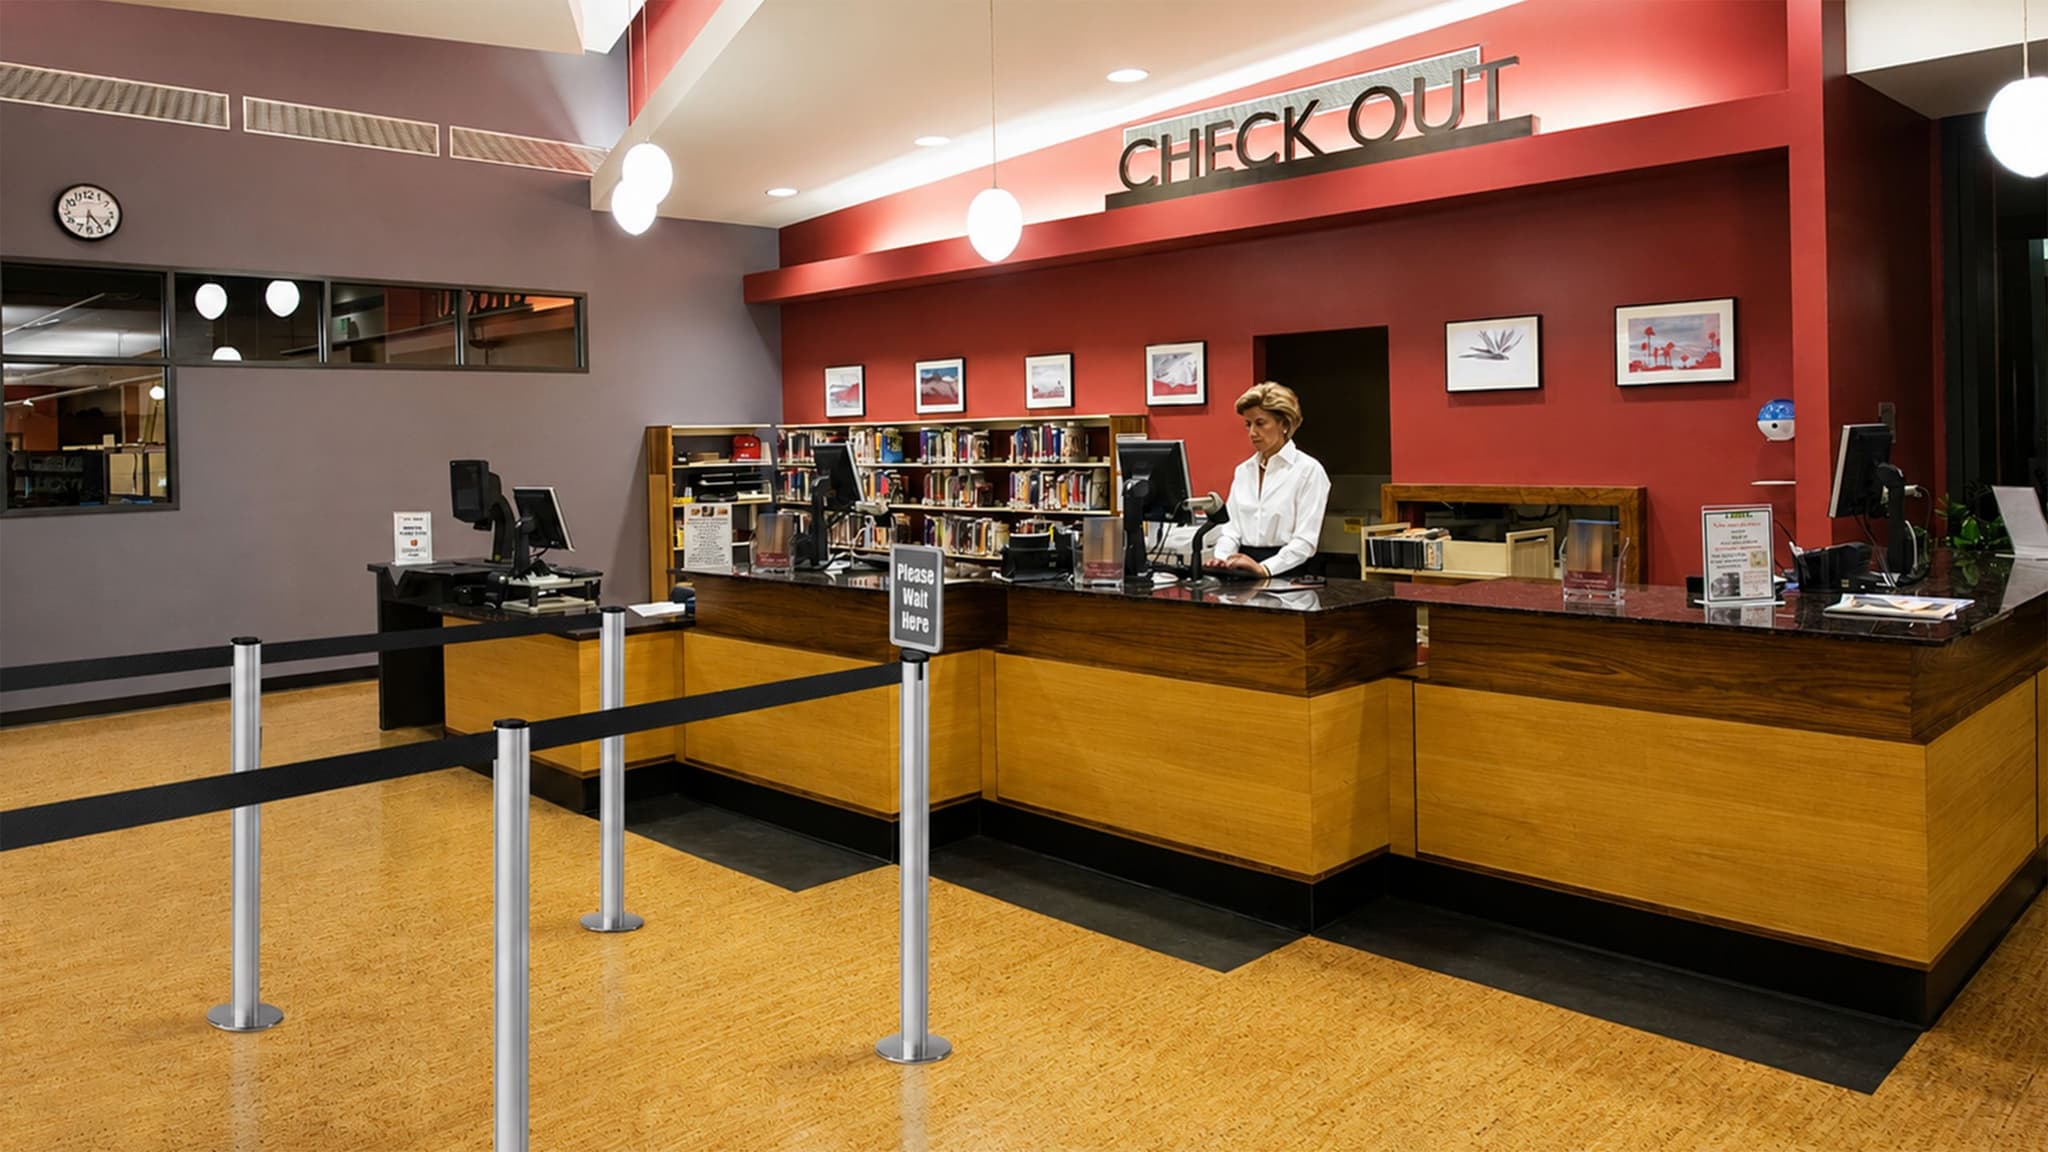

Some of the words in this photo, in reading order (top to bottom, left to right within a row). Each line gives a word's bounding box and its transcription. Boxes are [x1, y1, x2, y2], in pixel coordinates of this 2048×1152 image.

[1119, 98, 1322, 191] CHECK
[1348, 55, 1520, 148] OUT
[896, 563, 935, 586] Please
[902, 587, 929, 609] Wait
[901, 610, 930, 634] Here
